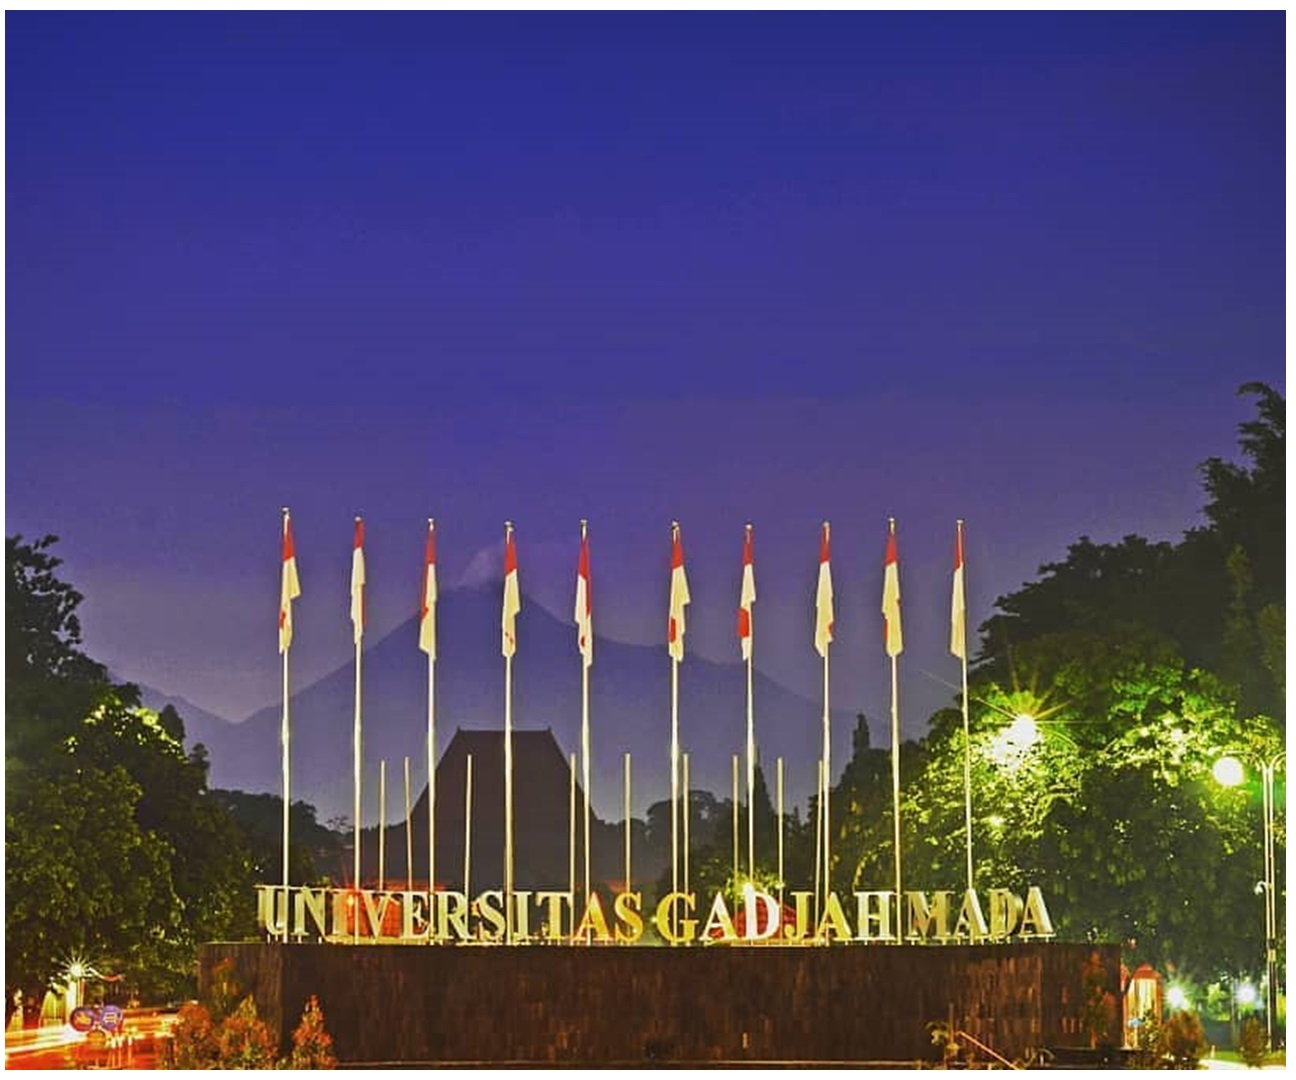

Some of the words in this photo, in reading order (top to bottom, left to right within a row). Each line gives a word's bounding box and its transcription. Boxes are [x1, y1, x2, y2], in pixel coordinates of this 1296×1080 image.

[256, 885, 643, 943] UNIVERSITAS
[657, 884, 895, 942] GADJAH
[905, 886, 1056, 942] MADA
